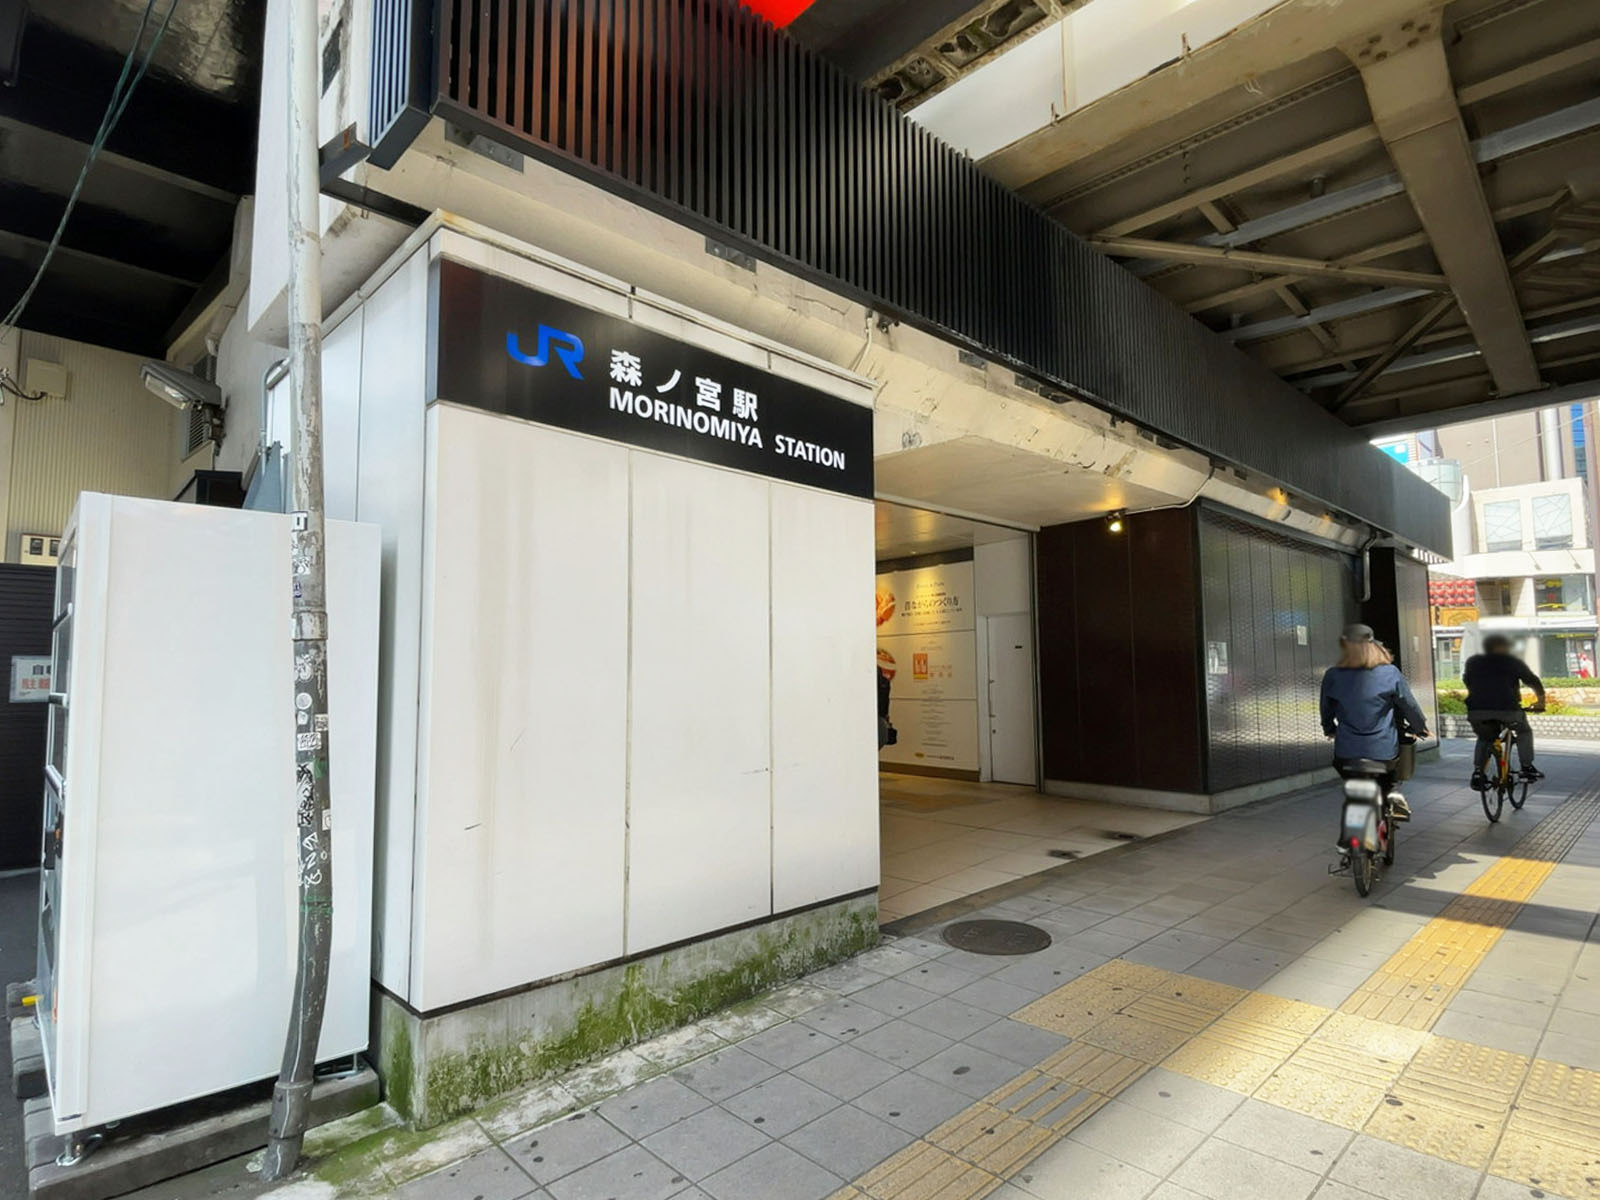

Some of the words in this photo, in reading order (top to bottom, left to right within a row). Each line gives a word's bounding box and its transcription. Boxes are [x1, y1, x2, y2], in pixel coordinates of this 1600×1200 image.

[506, 323, 585, 381] JR
[609, 348, 759, 422] 森ノ宮駅
[609, 387, 764, 449] MORINOMIYA
[774, 434, 846, 471] STATION
